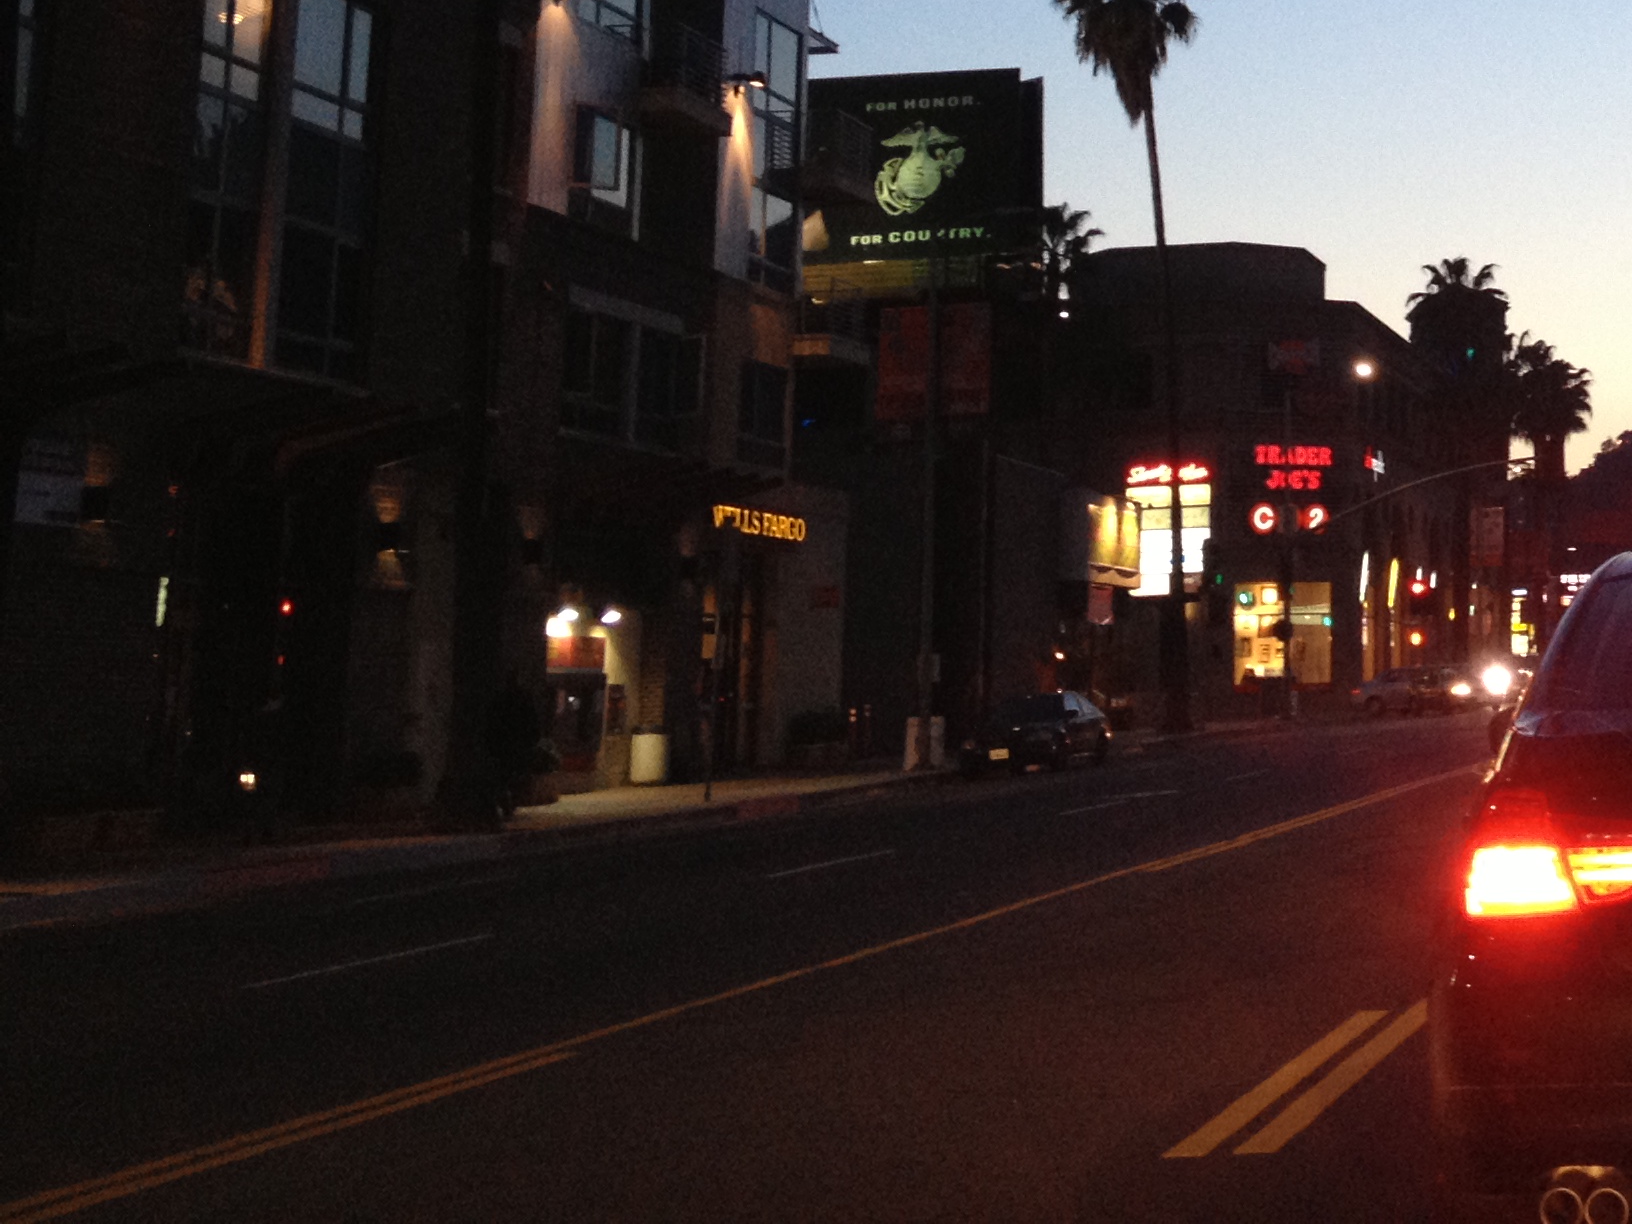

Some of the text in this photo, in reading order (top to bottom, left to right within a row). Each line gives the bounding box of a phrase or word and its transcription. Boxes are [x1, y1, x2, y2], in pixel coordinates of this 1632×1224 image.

[866, 102, 897, 112] FOR
[850, 234, 883, 246] FOR
[762, 513, 806, 541] FARGO
